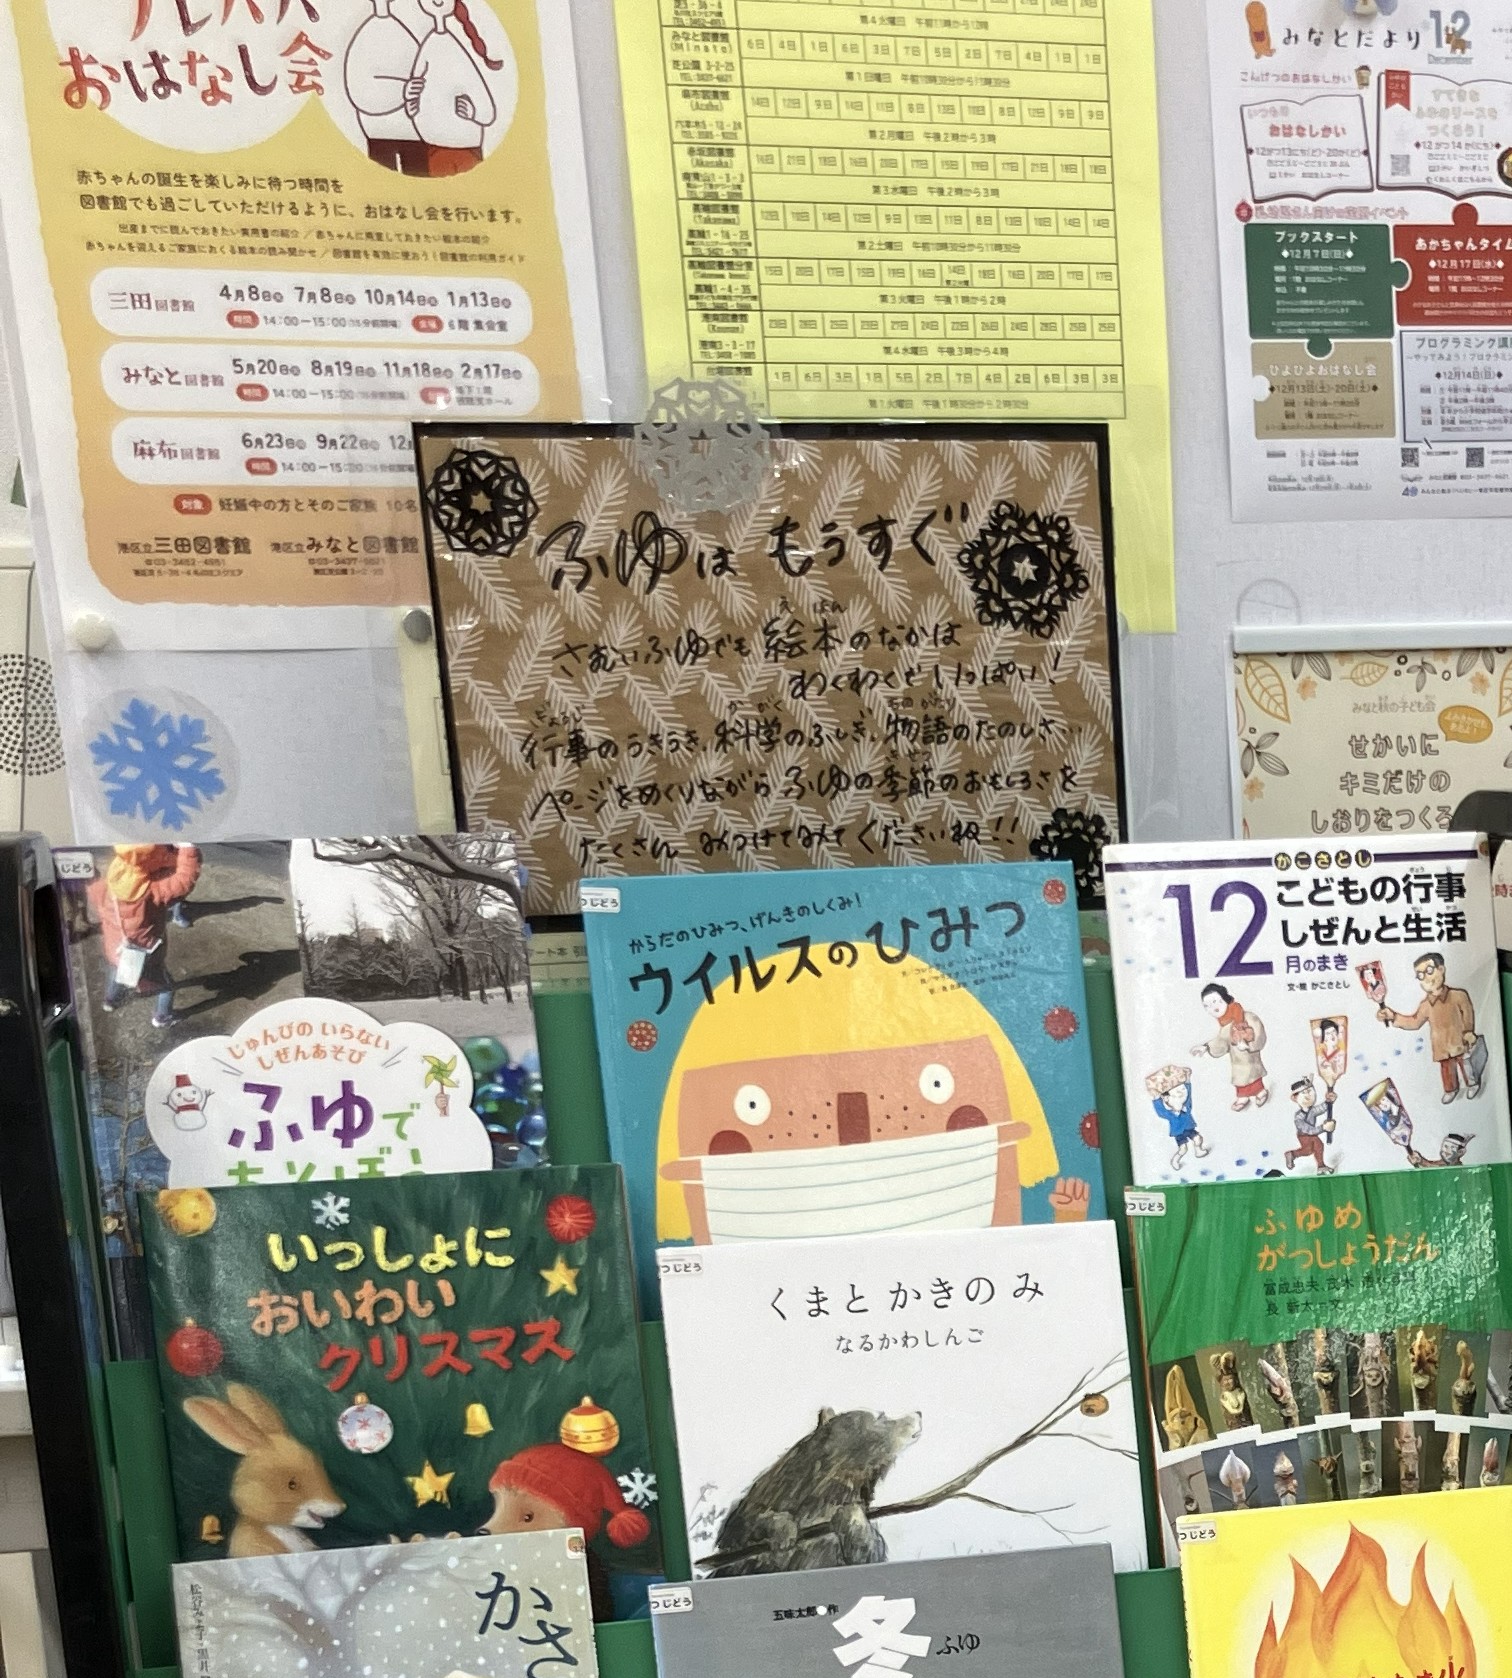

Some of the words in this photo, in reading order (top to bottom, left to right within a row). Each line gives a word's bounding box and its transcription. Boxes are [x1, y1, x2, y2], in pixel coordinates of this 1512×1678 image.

[1282, 27, 1421, 50] みなとだより
[59, 31, 333, 111] おはなし会
[77, 169, 344, 195] 赤ちゃんの誕生を楽しみに待つ時間を
[1274, 231, 1359, 244] ブックスタート
[123, 366, 224, 388] みなと図書館
[1269, 364, 1378, 377] ひよひよおはなし会
[537, 510, 738, 595] ふゆは
[767, 502, 970, 577] もうすぐ
[1348, 733, 1440, 759] せかいに
[1339, 768, 1451, 796] キミだけの
[1274, 848, 1373, 870] かこさとし
[1275, 871, 1467, 908] こどもの行事
[1162, 880, 1274, 979] 12
[1280, 911, 1467, 948] しぜんと生活
[628, 899, 1026, 1015] ウイルスのひみつ
[1285, 953, 1349, 975] 月のまき
[227, 1020, 313, 1062] じゅんびの
[320, 1022, 391, 1050] いらない
[255, 1042, 368, 1072] しぜんあそび
[227, 1079, 422, 1153] ふゆで
[1254, 1201, 1363, 1236] ふゆめ
[266, 1225, 516, 1275] いっしょに
[1255, 1231, 1441, 1273] がっしょうだん
[247, 1278, 457, 1337] おいわい
[768, 1283, 870, 1321] くまと
[888, 1275, 995, 1312] かきの
[1012, 1272, 1045, 1303] み
[318, 1317, 576, 1393] クリスマス
[835, 1327, 985, 1354] なるかわしんご
[936, 1632, 981, 1656] ふゆ
